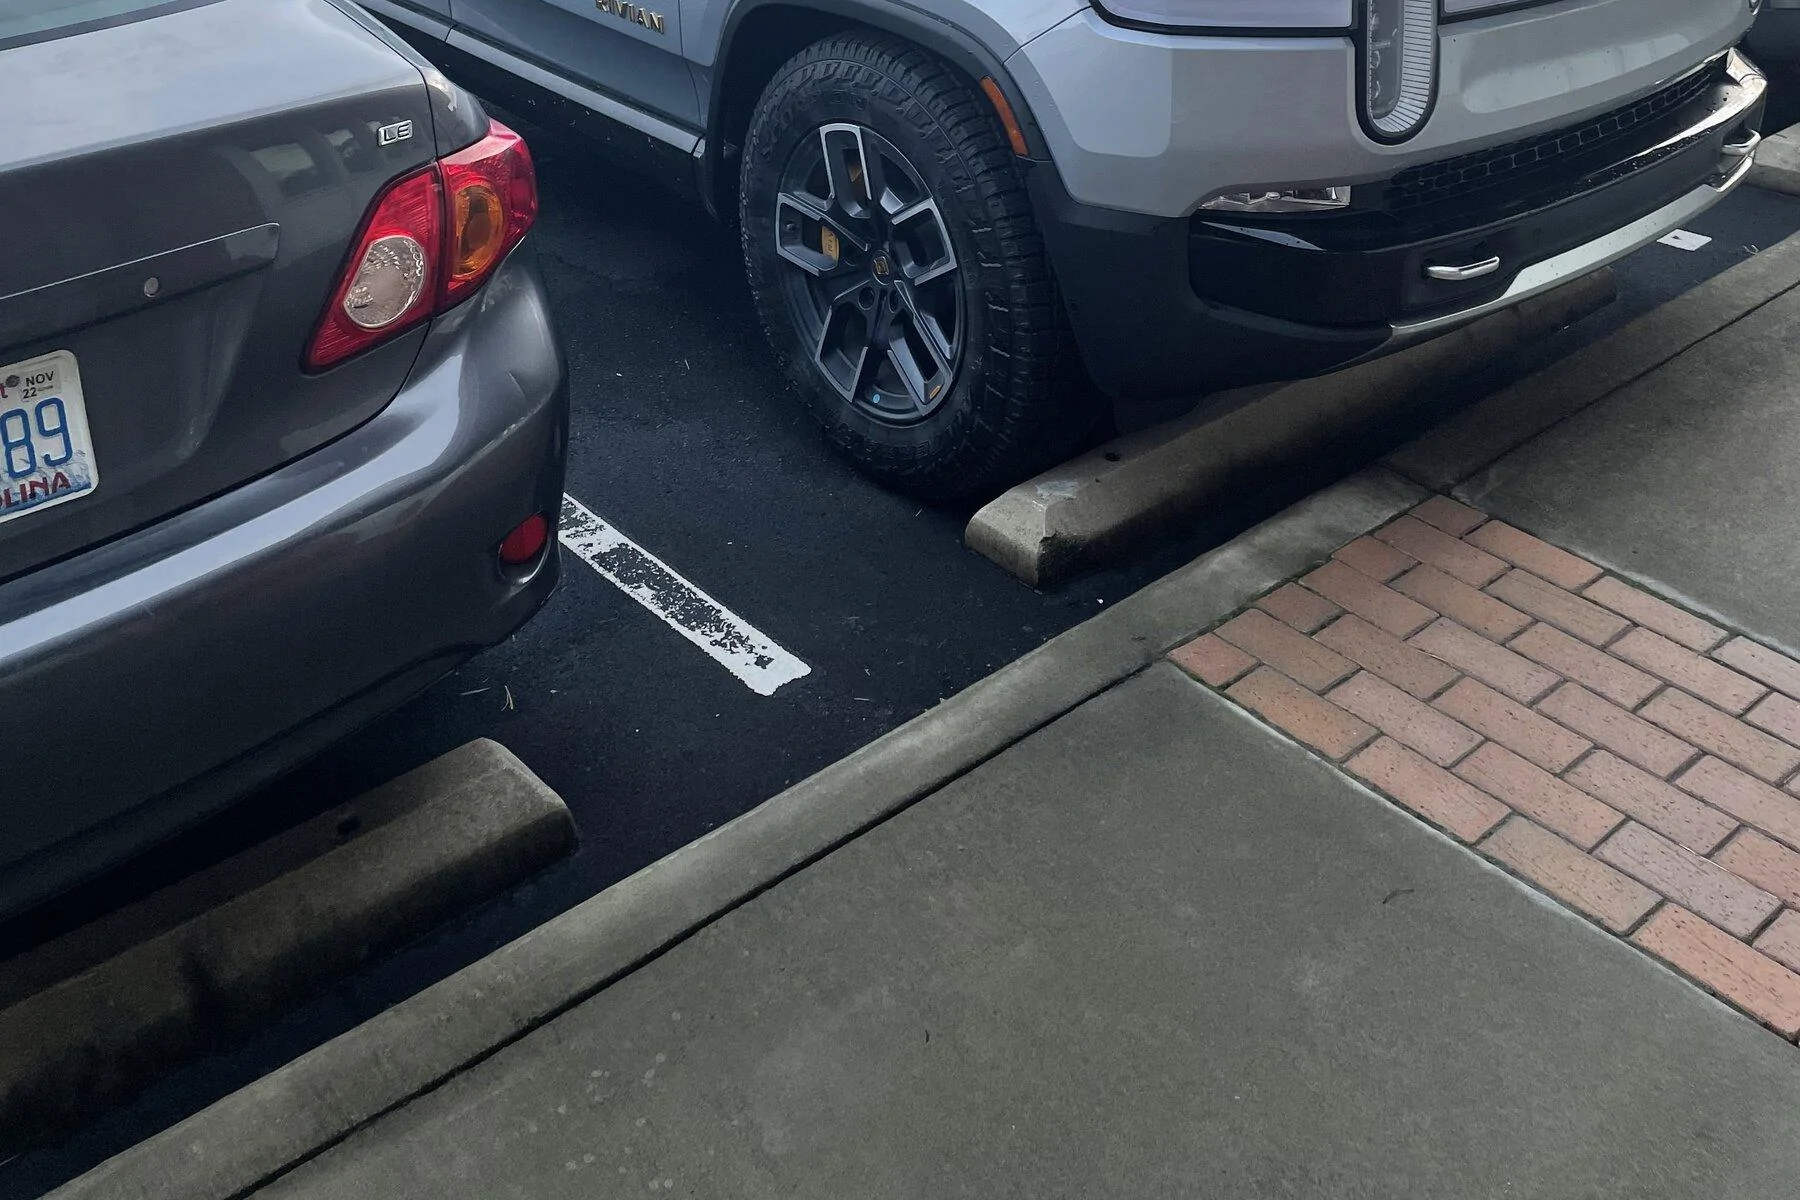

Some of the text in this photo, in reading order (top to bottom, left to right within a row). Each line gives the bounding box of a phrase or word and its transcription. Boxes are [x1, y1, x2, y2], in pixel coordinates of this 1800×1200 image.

[378, 119, 413, 147] LE
[25, 370, 54, 387] NOV
[22, 386, 38, 400] 22
[0, 397, 74, 480] 89
